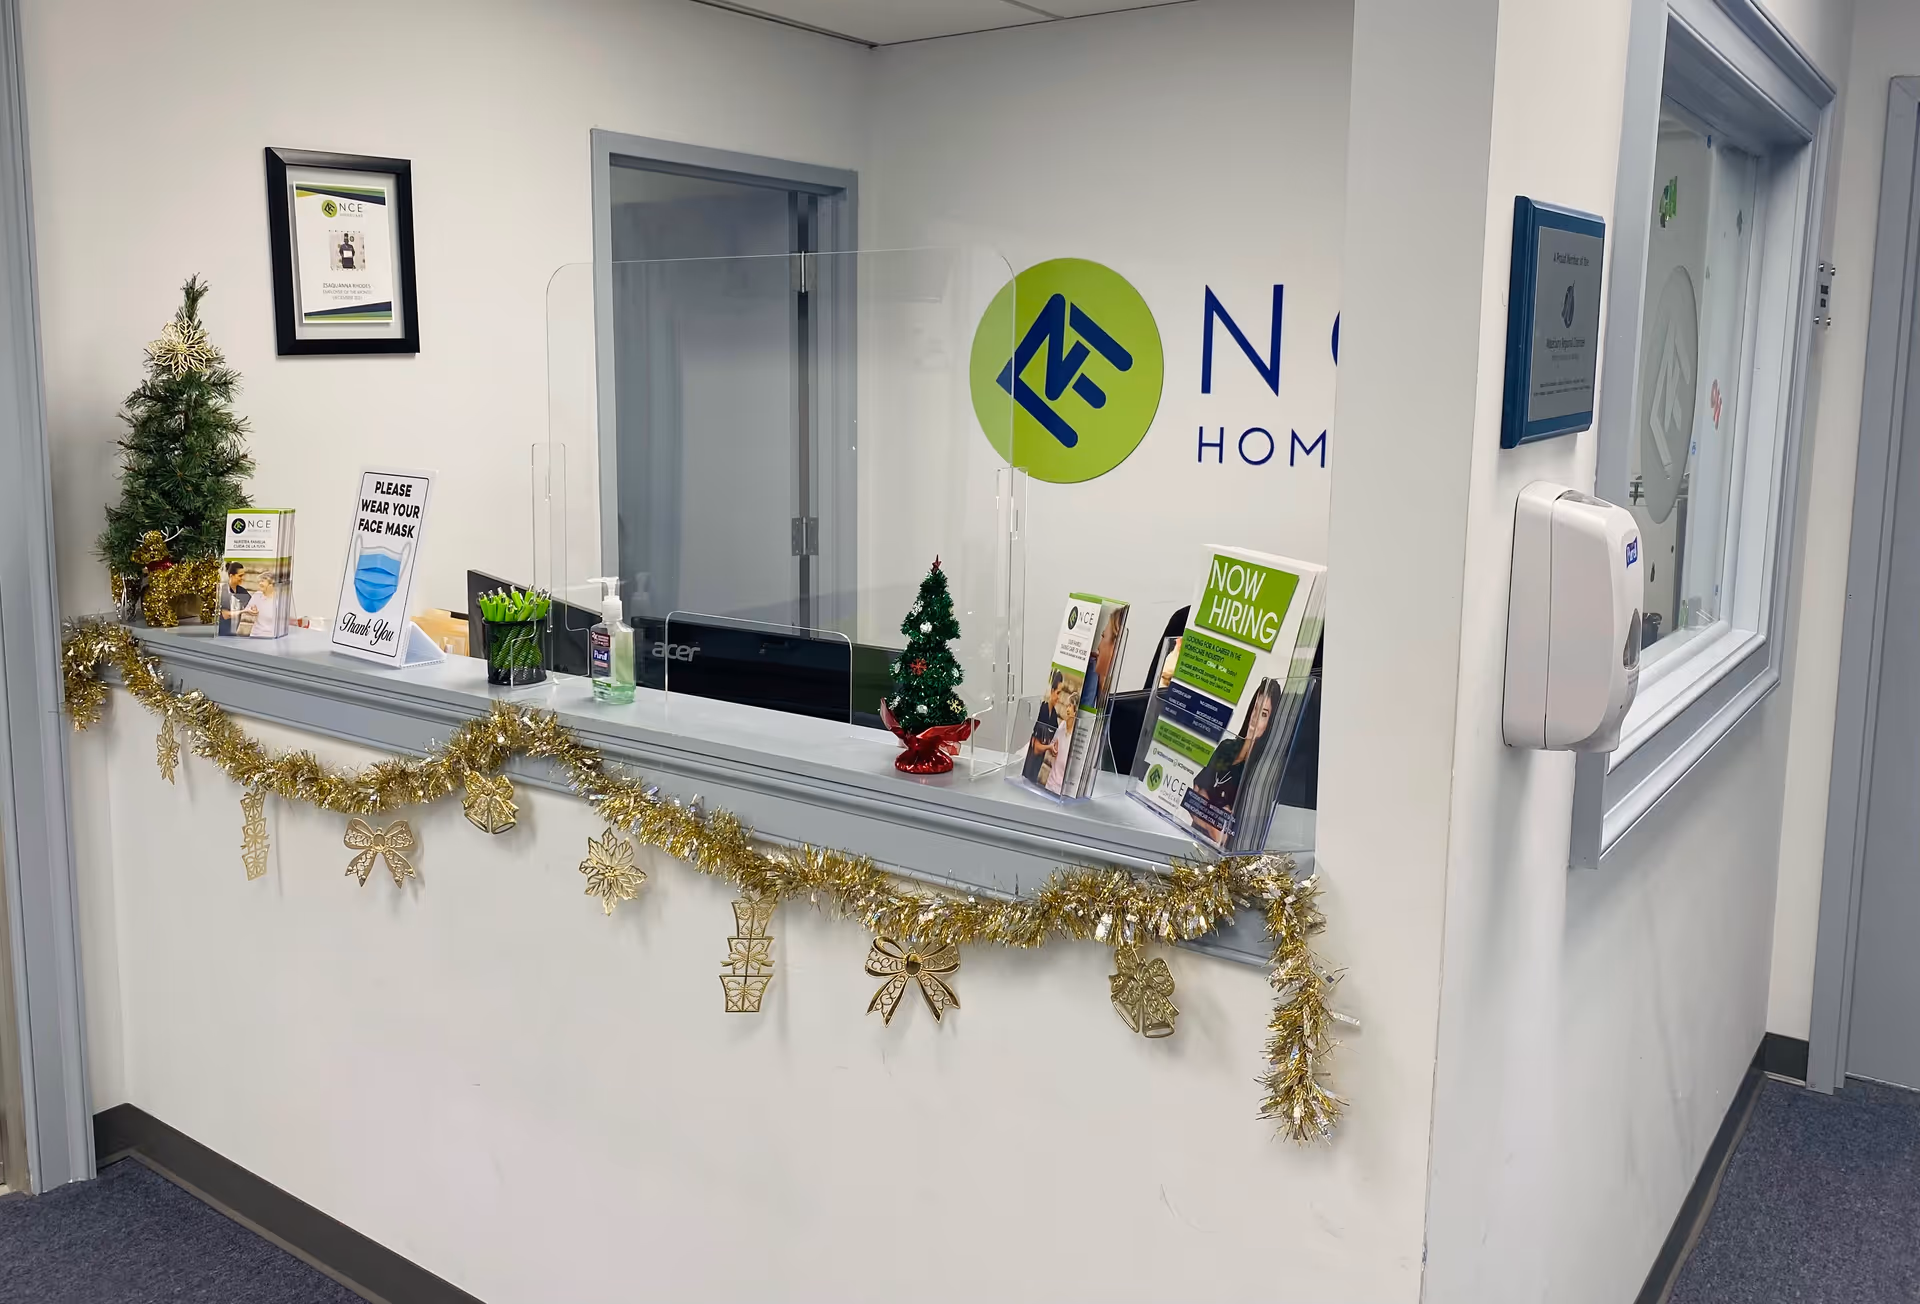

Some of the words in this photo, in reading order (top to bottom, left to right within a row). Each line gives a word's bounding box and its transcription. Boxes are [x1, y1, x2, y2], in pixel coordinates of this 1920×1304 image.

[374, 481, 412, 498] PLEASE
[361, 498, 390, 515] WEAR
[392, 502, 420, 519] YOUR
[247, 519, 271, 529] NCE
[358, 518, 383, 534] FACE
[384, 521, 415, 539] MASK
[1210, 559, 1266, 602] NOW
[339, 612, 372, 637] Thank
[370, 618, 394, 646] You
[1078, 611, 1095, 626] NCE
[1208, 595, 1278, 644] HIRING
[652, 641, 700, 662] acer
[1162, 773, 1186, 797] NCE
